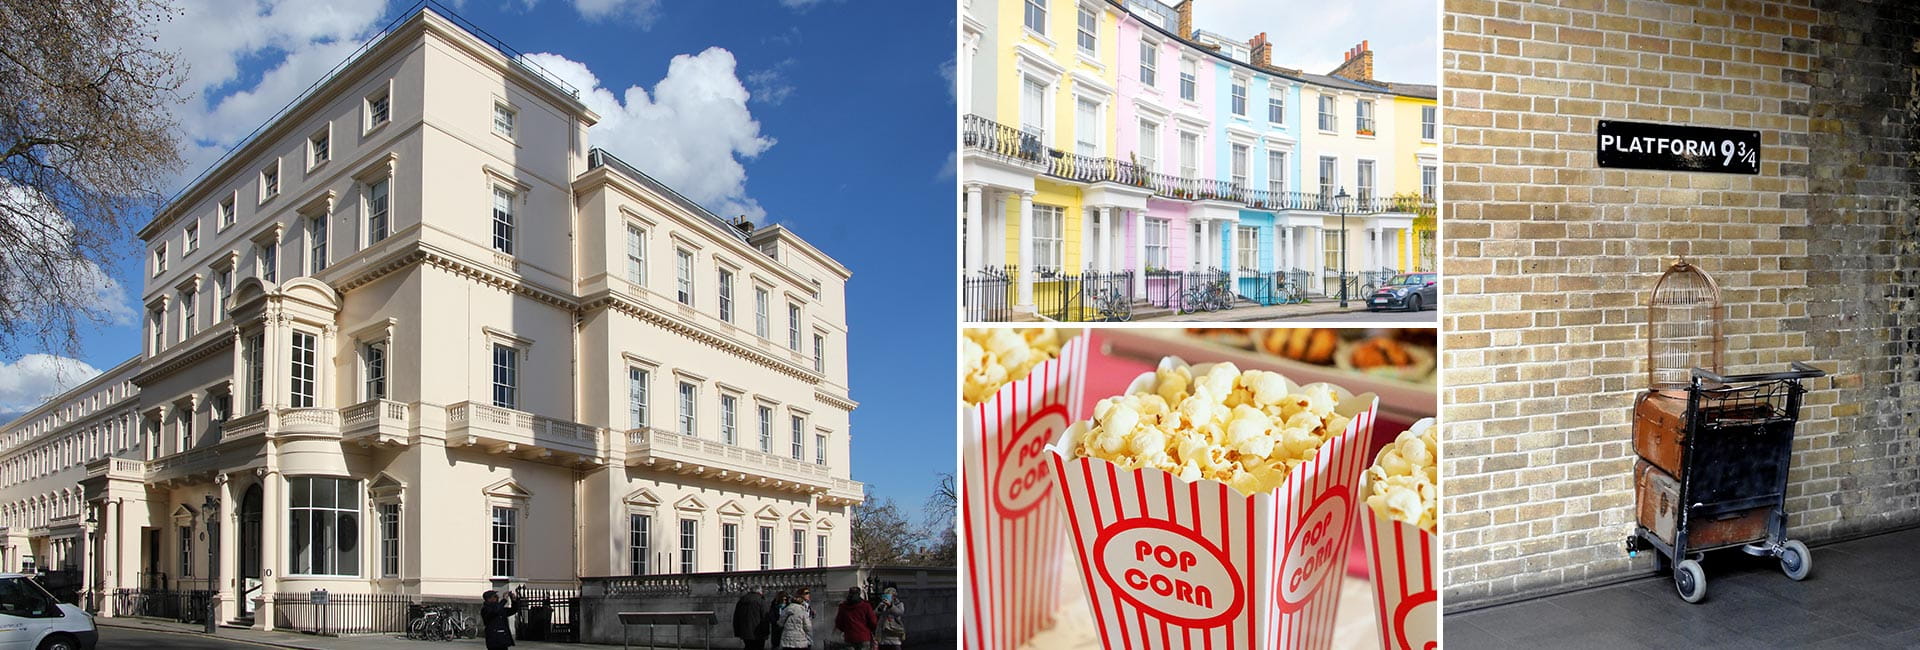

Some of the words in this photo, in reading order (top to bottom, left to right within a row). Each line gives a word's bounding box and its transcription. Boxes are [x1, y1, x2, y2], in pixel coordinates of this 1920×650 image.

[1601, 134, 1716, 157] PLATFORM
[1018, 427, 1052, 469] POP
[1009, 460, 1050, 501] COR
[1300, 510, 1333, 556] POP
[1135, 540, 1197, 573] POP
[1125, 568, 1213, 609] CORN
